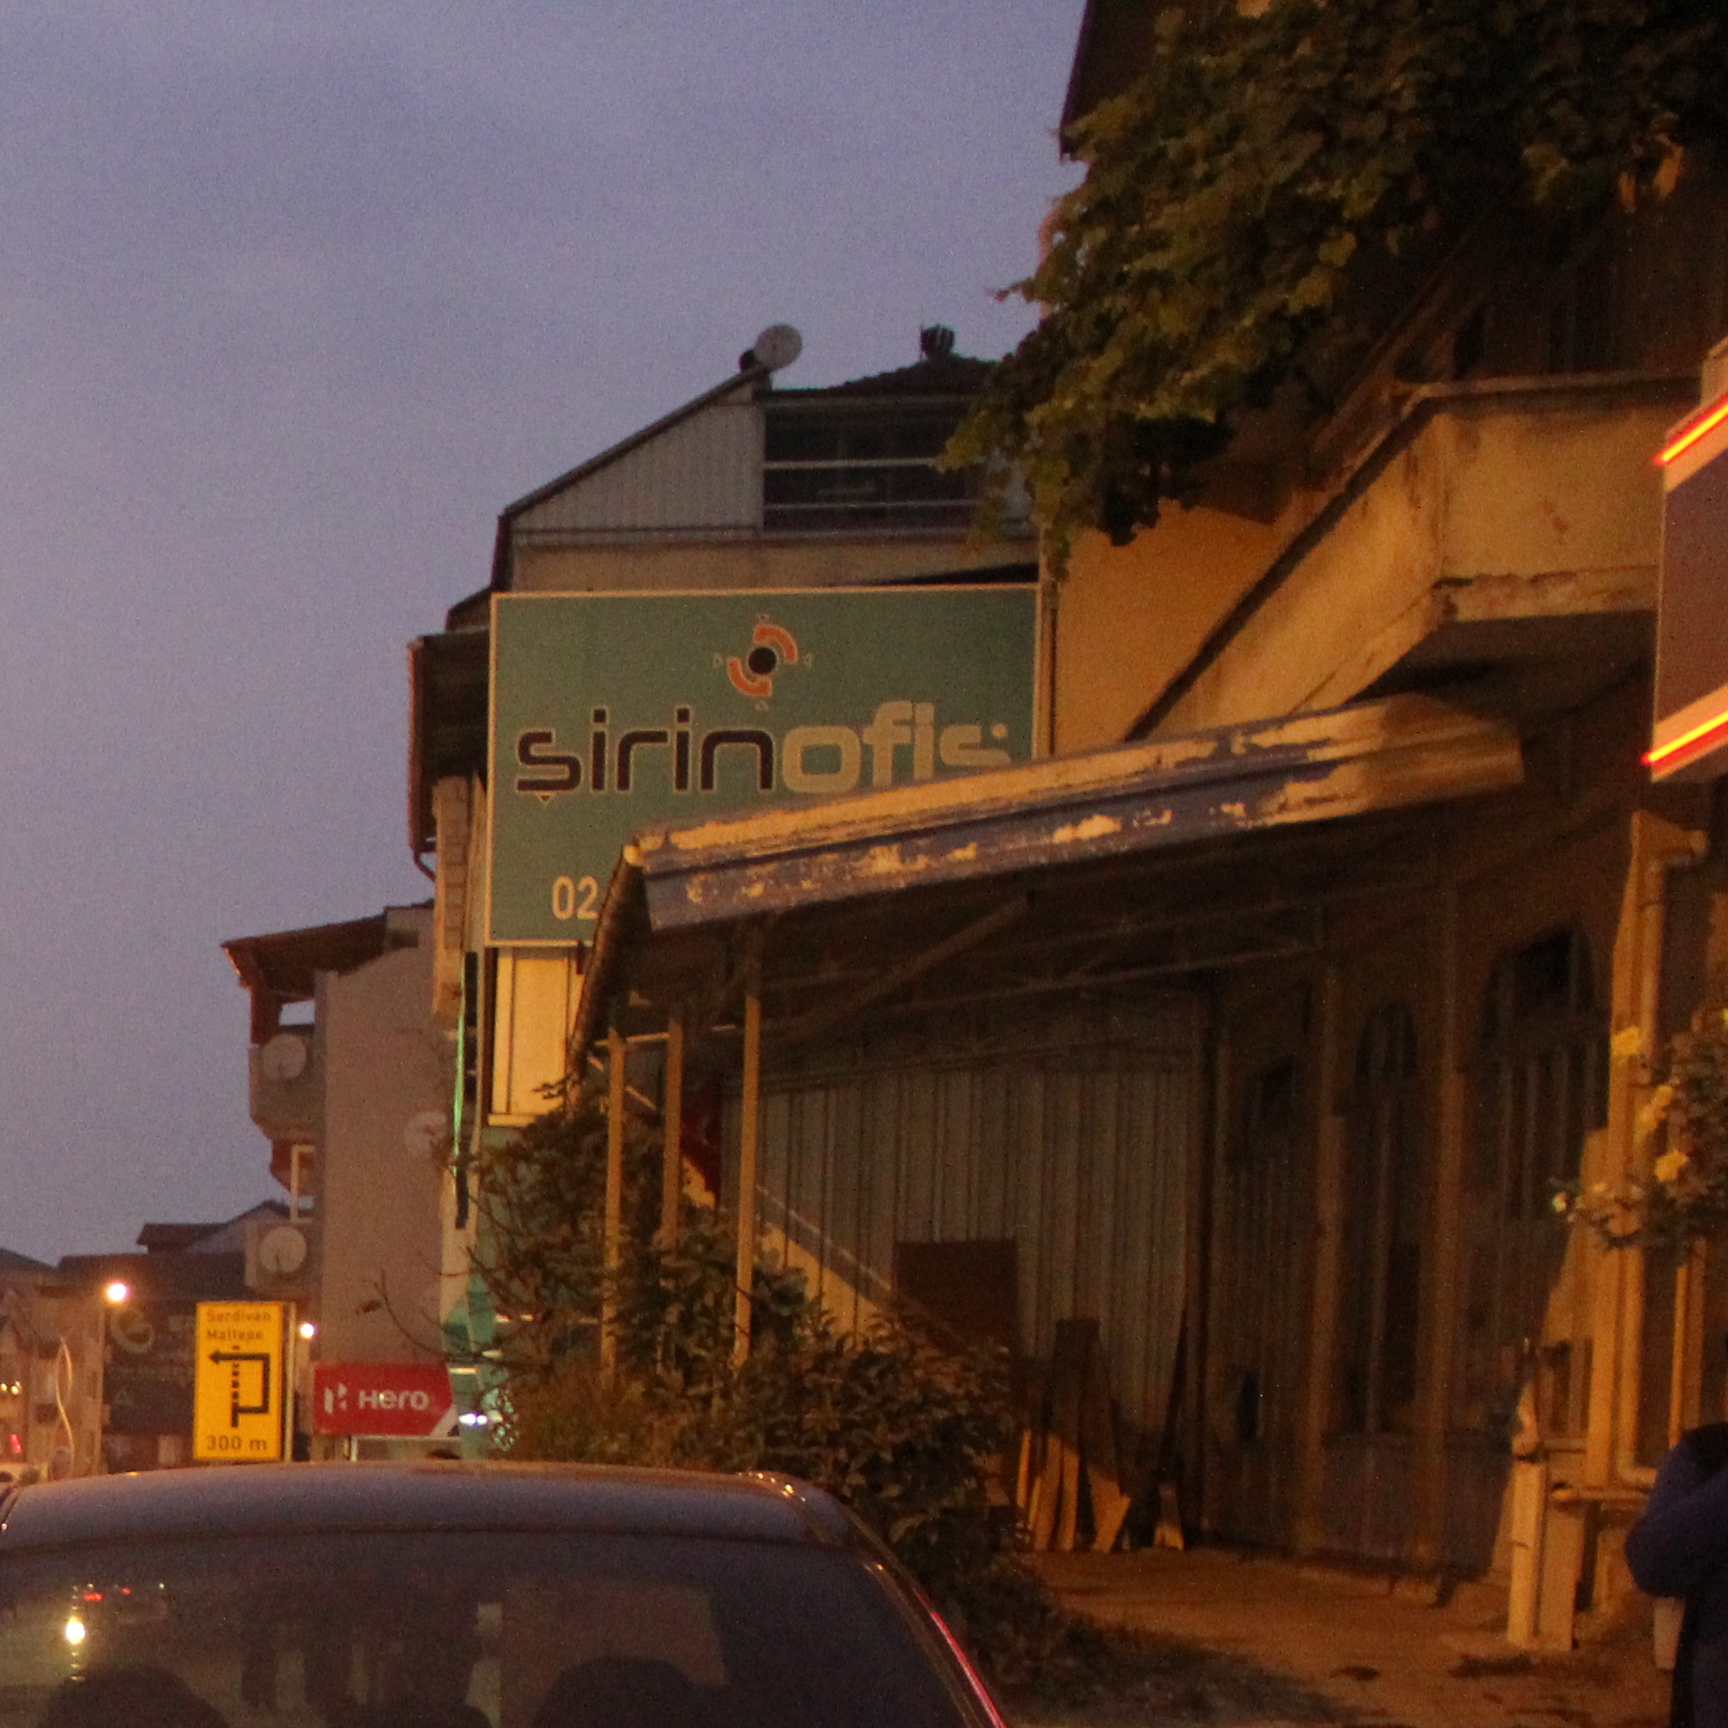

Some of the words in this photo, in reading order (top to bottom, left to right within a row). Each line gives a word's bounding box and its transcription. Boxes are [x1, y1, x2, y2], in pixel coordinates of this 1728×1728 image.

[206, 1309, 272, 1323] Serdivan
[206, 1436, 242, 1451] 300
[249, 1438, 267, 1451] m
